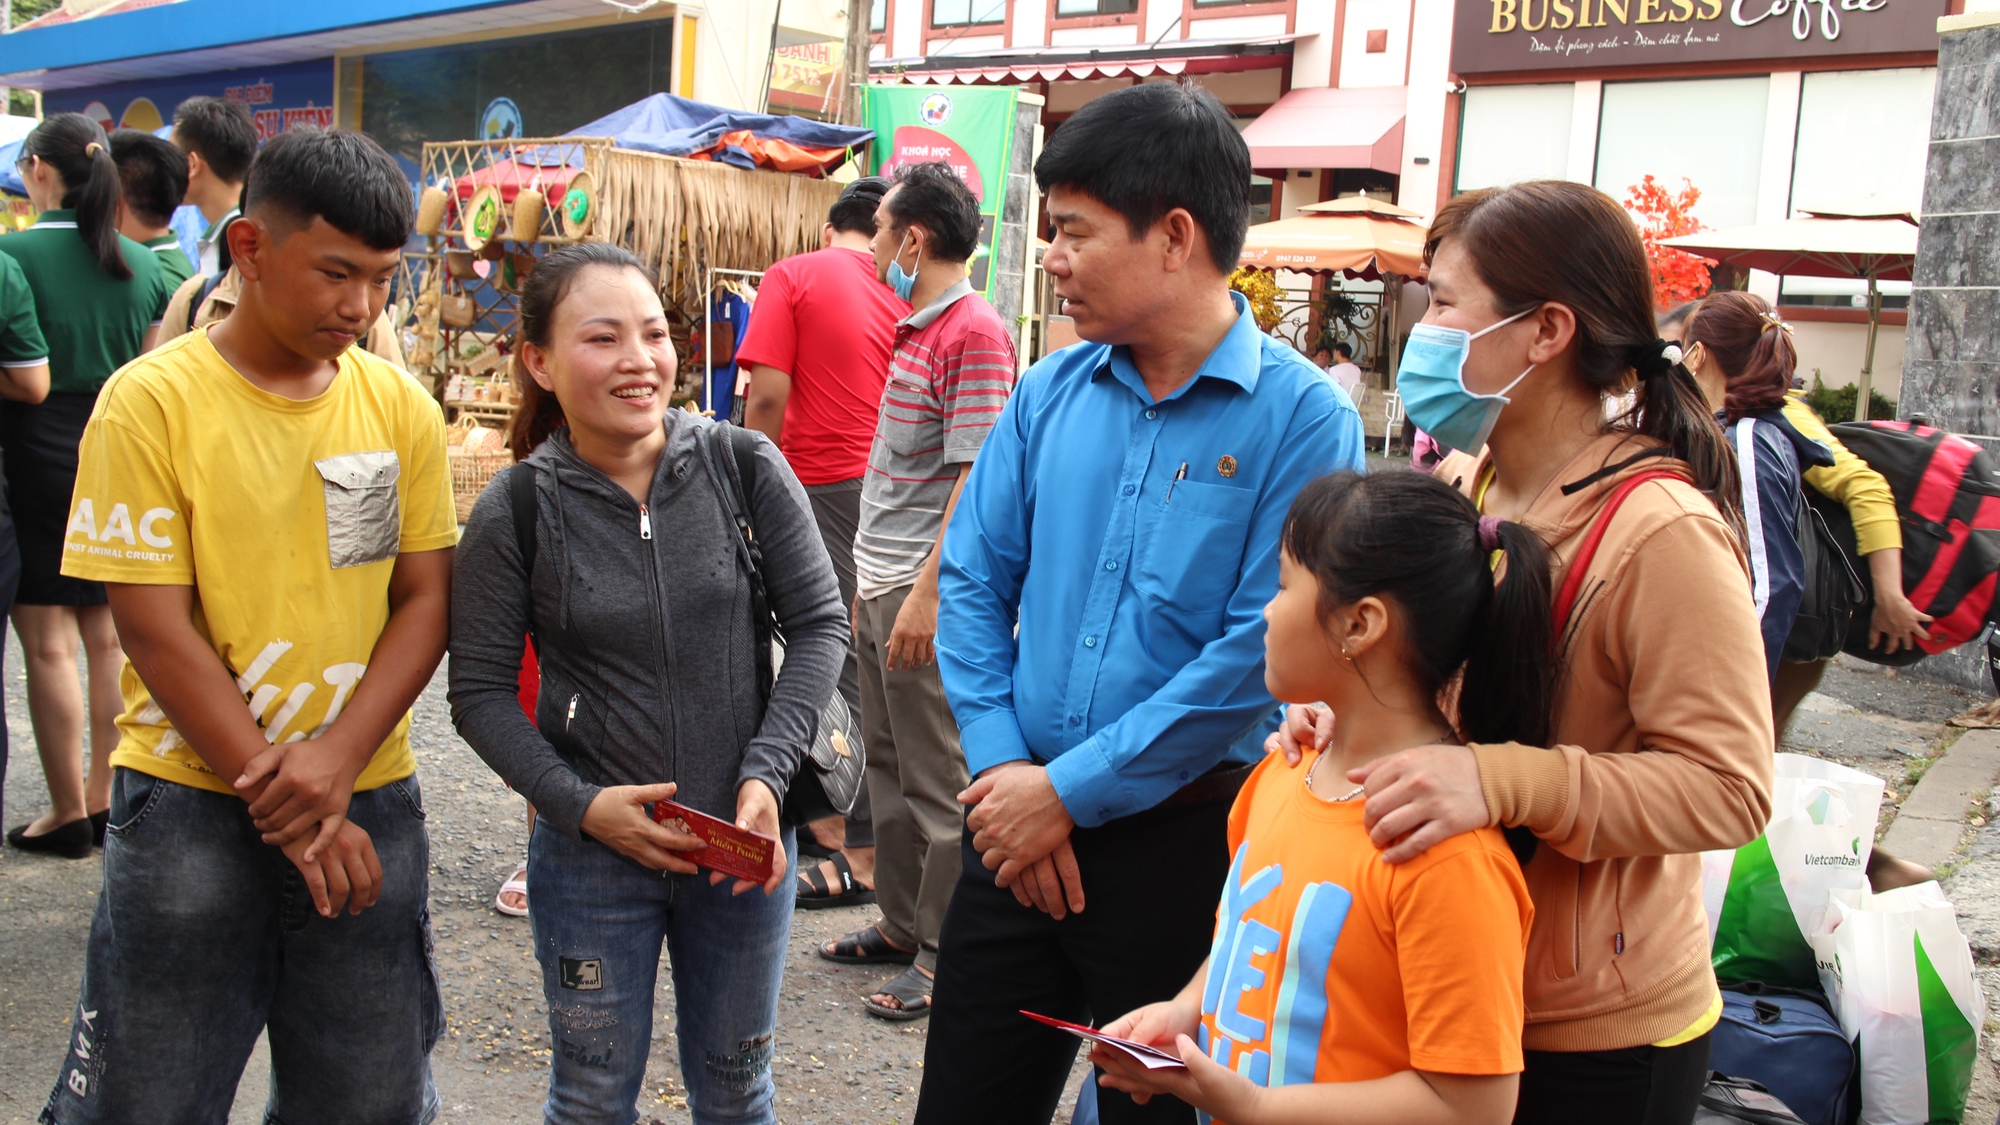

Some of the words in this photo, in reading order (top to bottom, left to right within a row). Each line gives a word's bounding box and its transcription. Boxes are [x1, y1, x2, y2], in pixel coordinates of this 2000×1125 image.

[1488, 0, 1723, 33] BUSINESS
[782, 63, 821, 86] 7512
[901, 145, 928, 157] KHOÁ
[931, 147, 952, 158] HỌC
[88, 546, 123, 558] ANIMAL
[126, 551, 174, 562] CRUELTY
[68, 1002, 98, 1098] BMX
